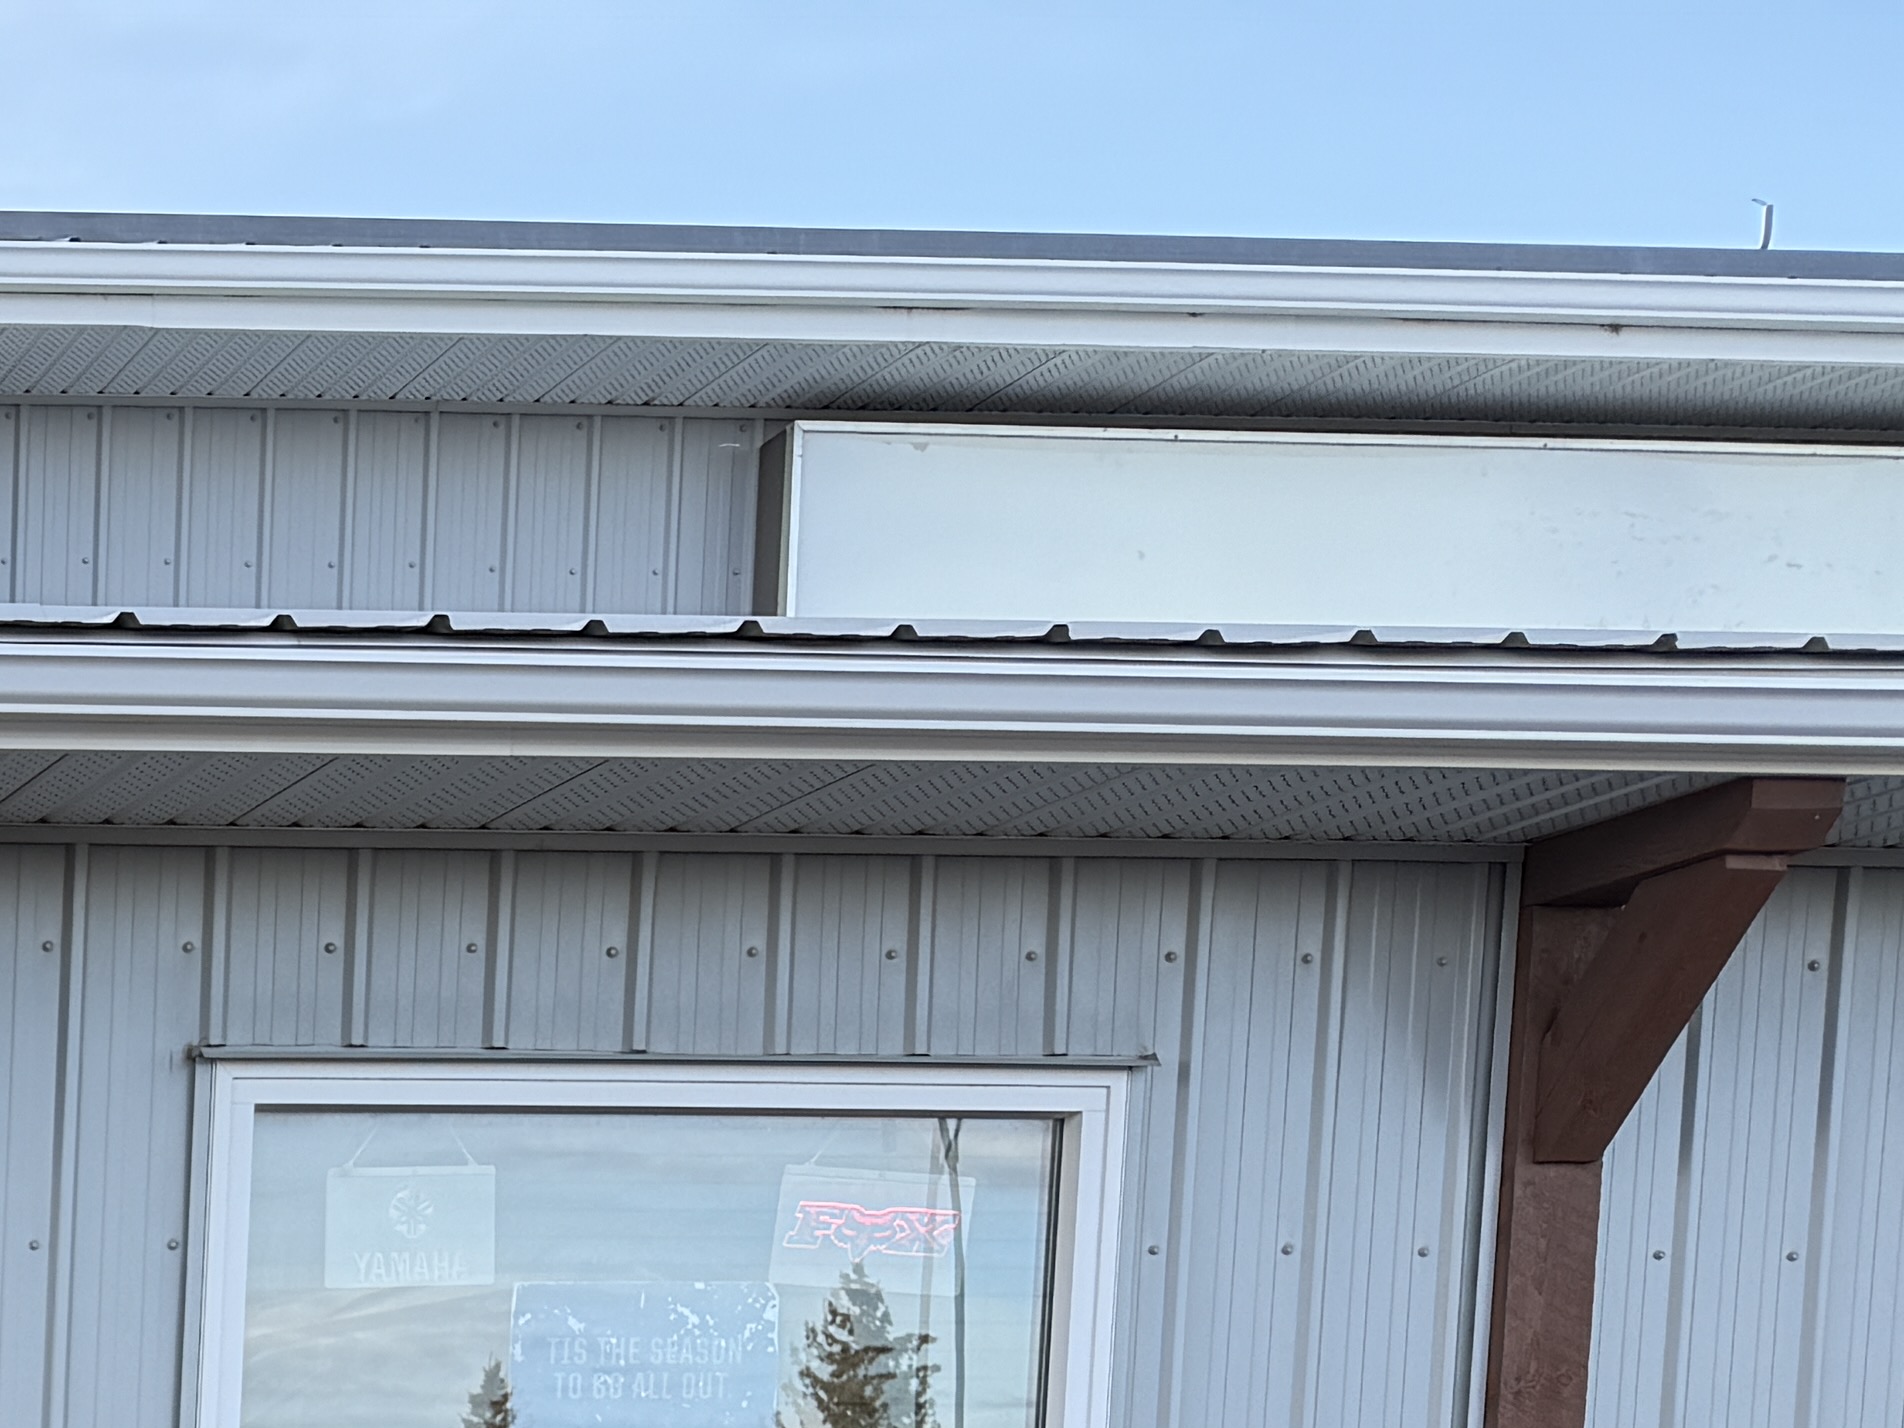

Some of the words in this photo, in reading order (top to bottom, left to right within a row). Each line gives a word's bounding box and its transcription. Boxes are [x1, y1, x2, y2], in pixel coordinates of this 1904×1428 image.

[353, 1251, 469, 1283] YAMAHA
[596, 1336, 642, 1365] THE
[649, 1335, 744, 1365] SEASON
[553, 1371, 583, 1400] TO
[631, 1370, 674, 1400] ALL
[680, 1371, 729, 1400] OUT
